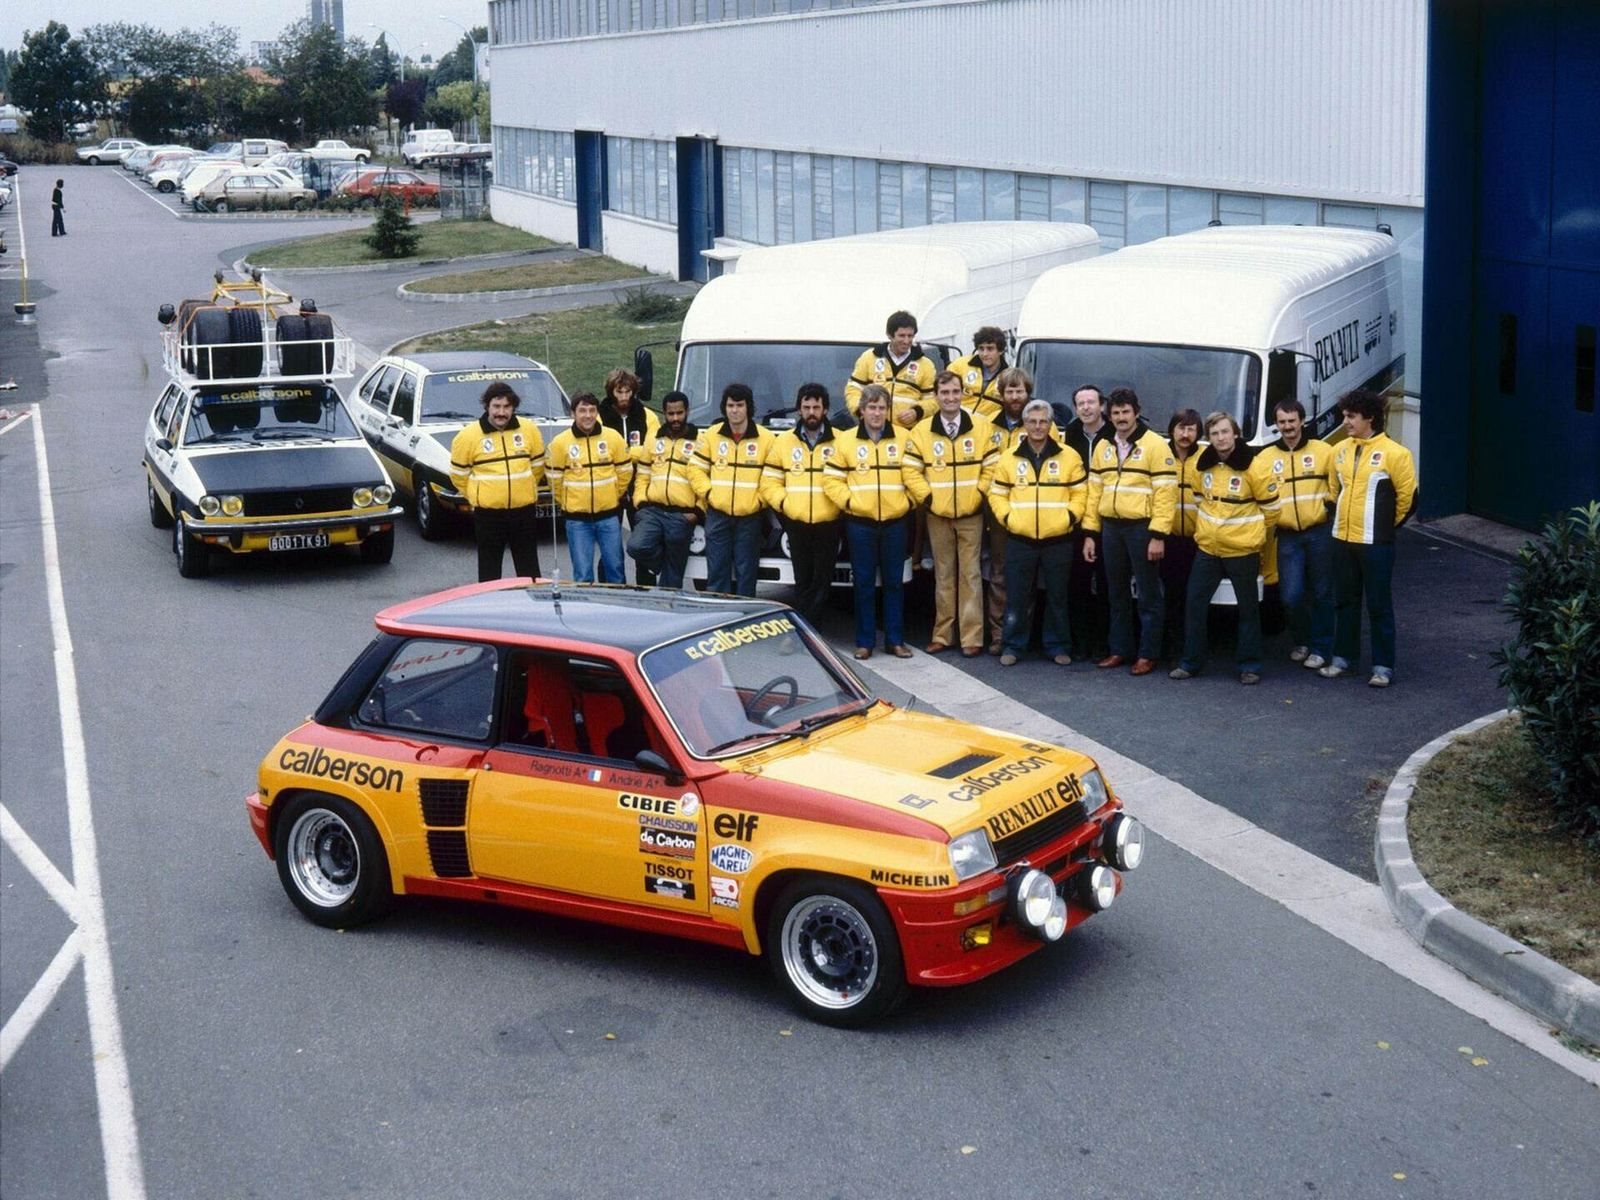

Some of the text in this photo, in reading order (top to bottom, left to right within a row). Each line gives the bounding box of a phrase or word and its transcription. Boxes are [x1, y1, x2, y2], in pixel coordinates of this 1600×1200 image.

[457, 371, 522, 382] calberson
[230, 389, 304, 400] calberson
[698, 618, 788, 656] calberson
[280, 747, 404, 793] calberson
[948, 755, 1053, 802] calberson
[986, 773, 1083, 839] RENAULT elf
[639, 814, 698, 832] CHAUSSON
[714, 813, 759, 841] elf
[640, 830, 695, 849] de Carbon
[644, 862, 694, 880] TISSOT
[870, 869, 950, 886] MICHELIN
